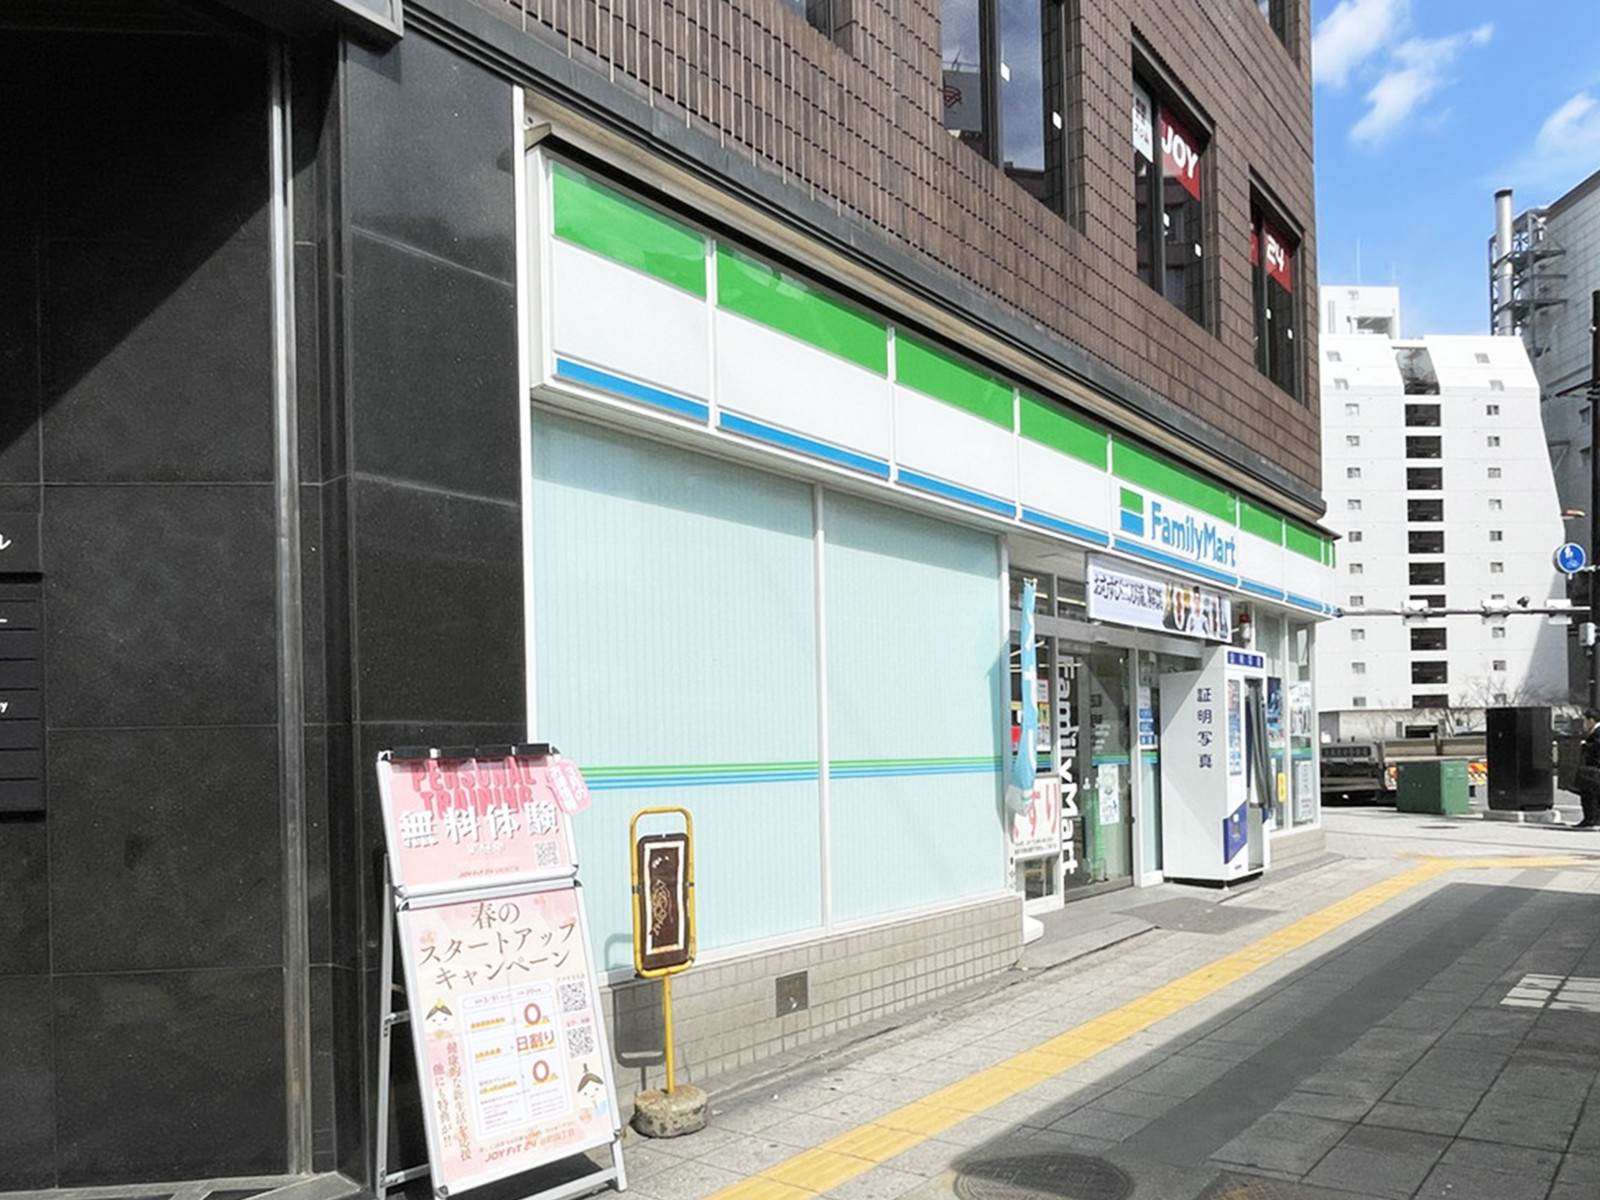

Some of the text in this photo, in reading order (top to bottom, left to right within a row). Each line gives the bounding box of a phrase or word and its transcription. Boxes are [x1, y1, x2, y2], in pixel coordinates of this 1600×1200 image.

[1162, 125, 1199, 179] JOY
[1266, 234, 1284, 273] 24
[1151, 500, 1236, 567] FamilyMart
[1197, 687, 1213, 769] 証明写真
[411, 756, 537, 792] PERSONAL
[420, 785, 535, 821] TRAINING
[401, 800, 560, 848] 無料体験
[472, 902, 521, 930] 春の
[418, 918, 577, 967] スタートアップ
[435, 951, 571, 990] キャンペーン
[516, 1030, 555, 1052] 日割り
